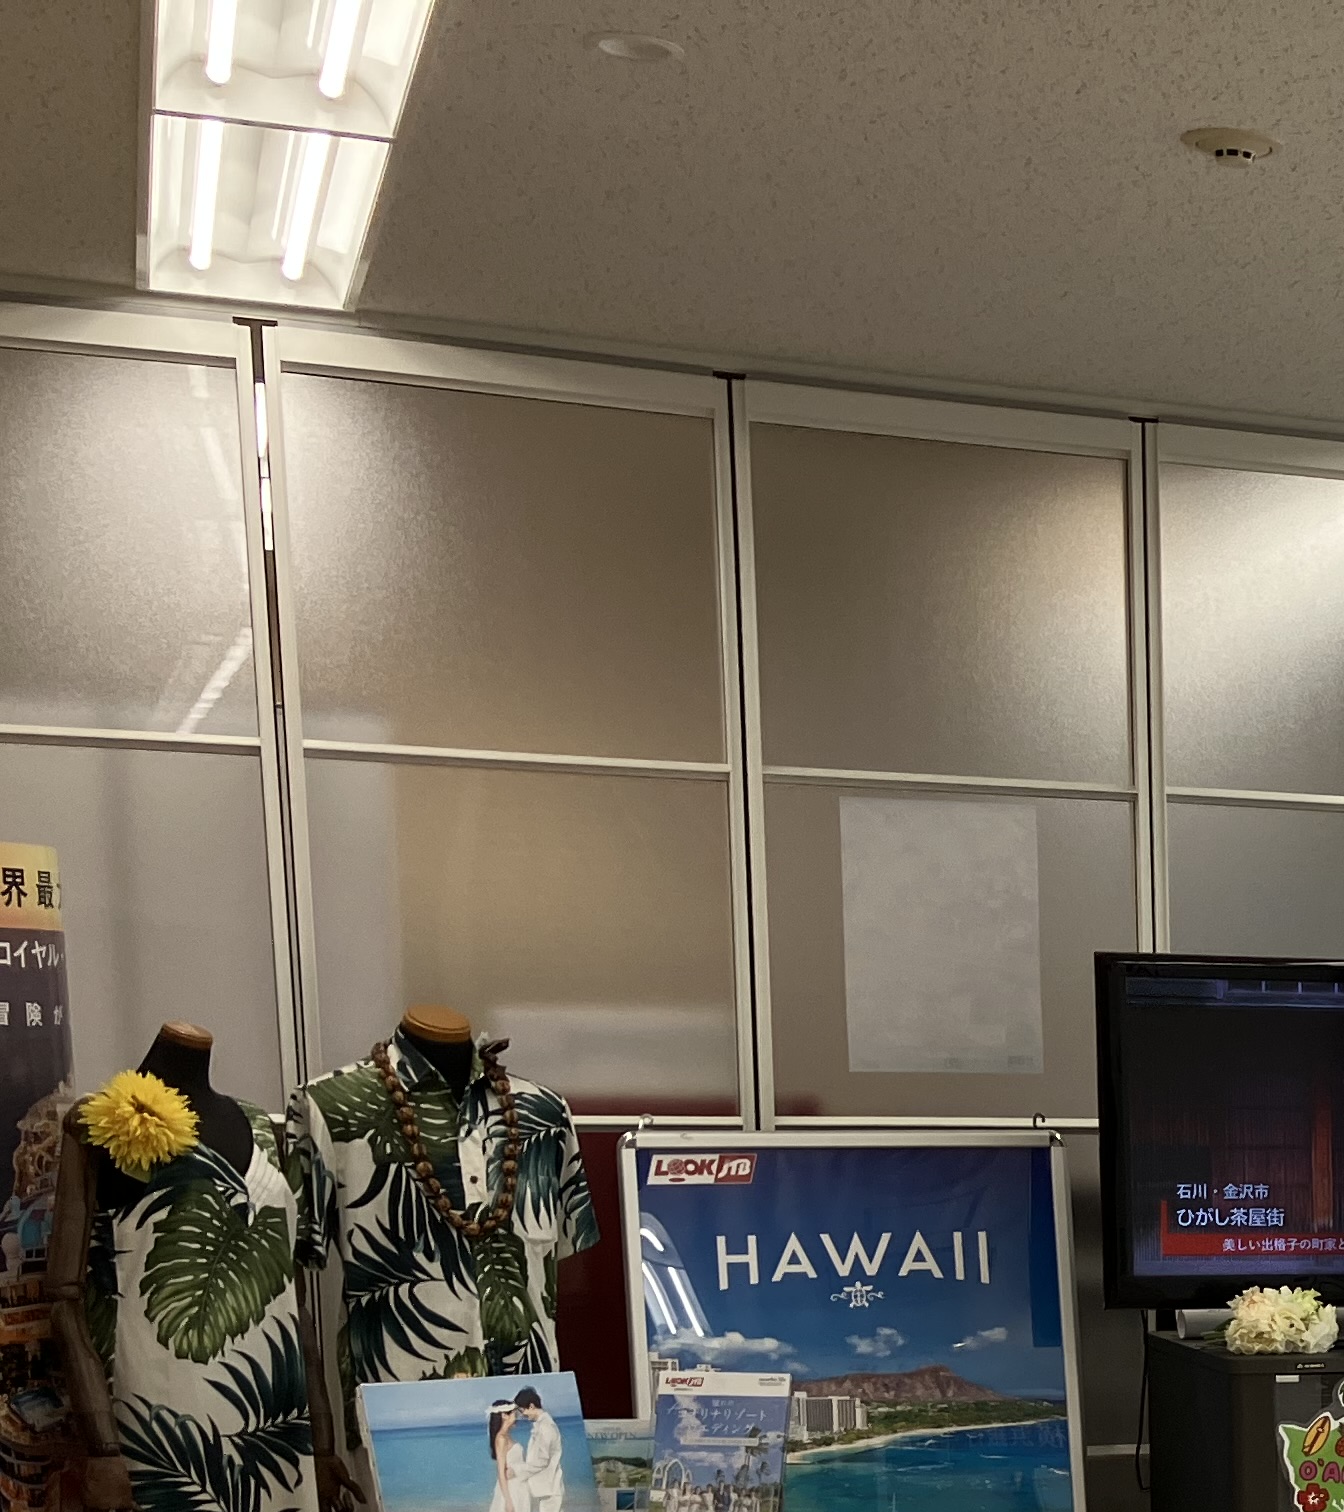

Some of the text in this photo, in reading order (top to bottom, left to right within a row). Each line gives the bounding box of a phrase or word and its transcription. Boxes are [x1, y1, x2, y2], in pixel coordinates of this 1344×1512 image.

[654, 1156, 752, 1182] LOOK JTB
[1176, 1182, 1270, 1201] 石川・金沢市
[1176, 1207, 1285, 1228] ひがし茶屋街
[716, 1229, 990, 1291] HAWAII
